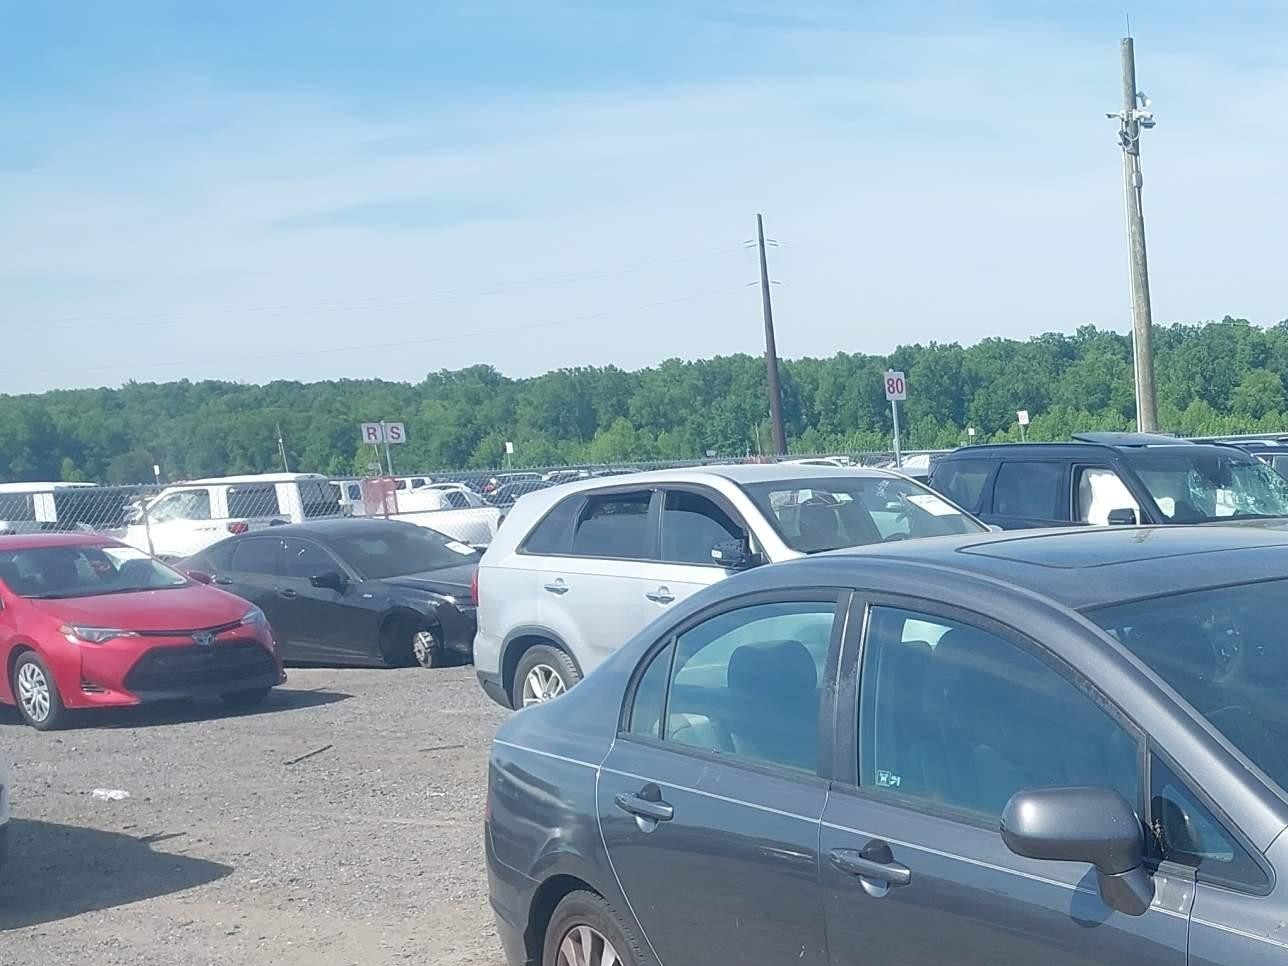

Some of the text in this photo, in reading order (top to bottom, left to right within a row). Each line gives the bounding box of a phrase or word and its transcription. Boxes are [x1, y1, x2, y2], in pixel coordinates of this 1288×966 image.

[886, 377, 904, 394] 80
[367, 426, 377, 440] R
[390, 425, 401, 440] S
